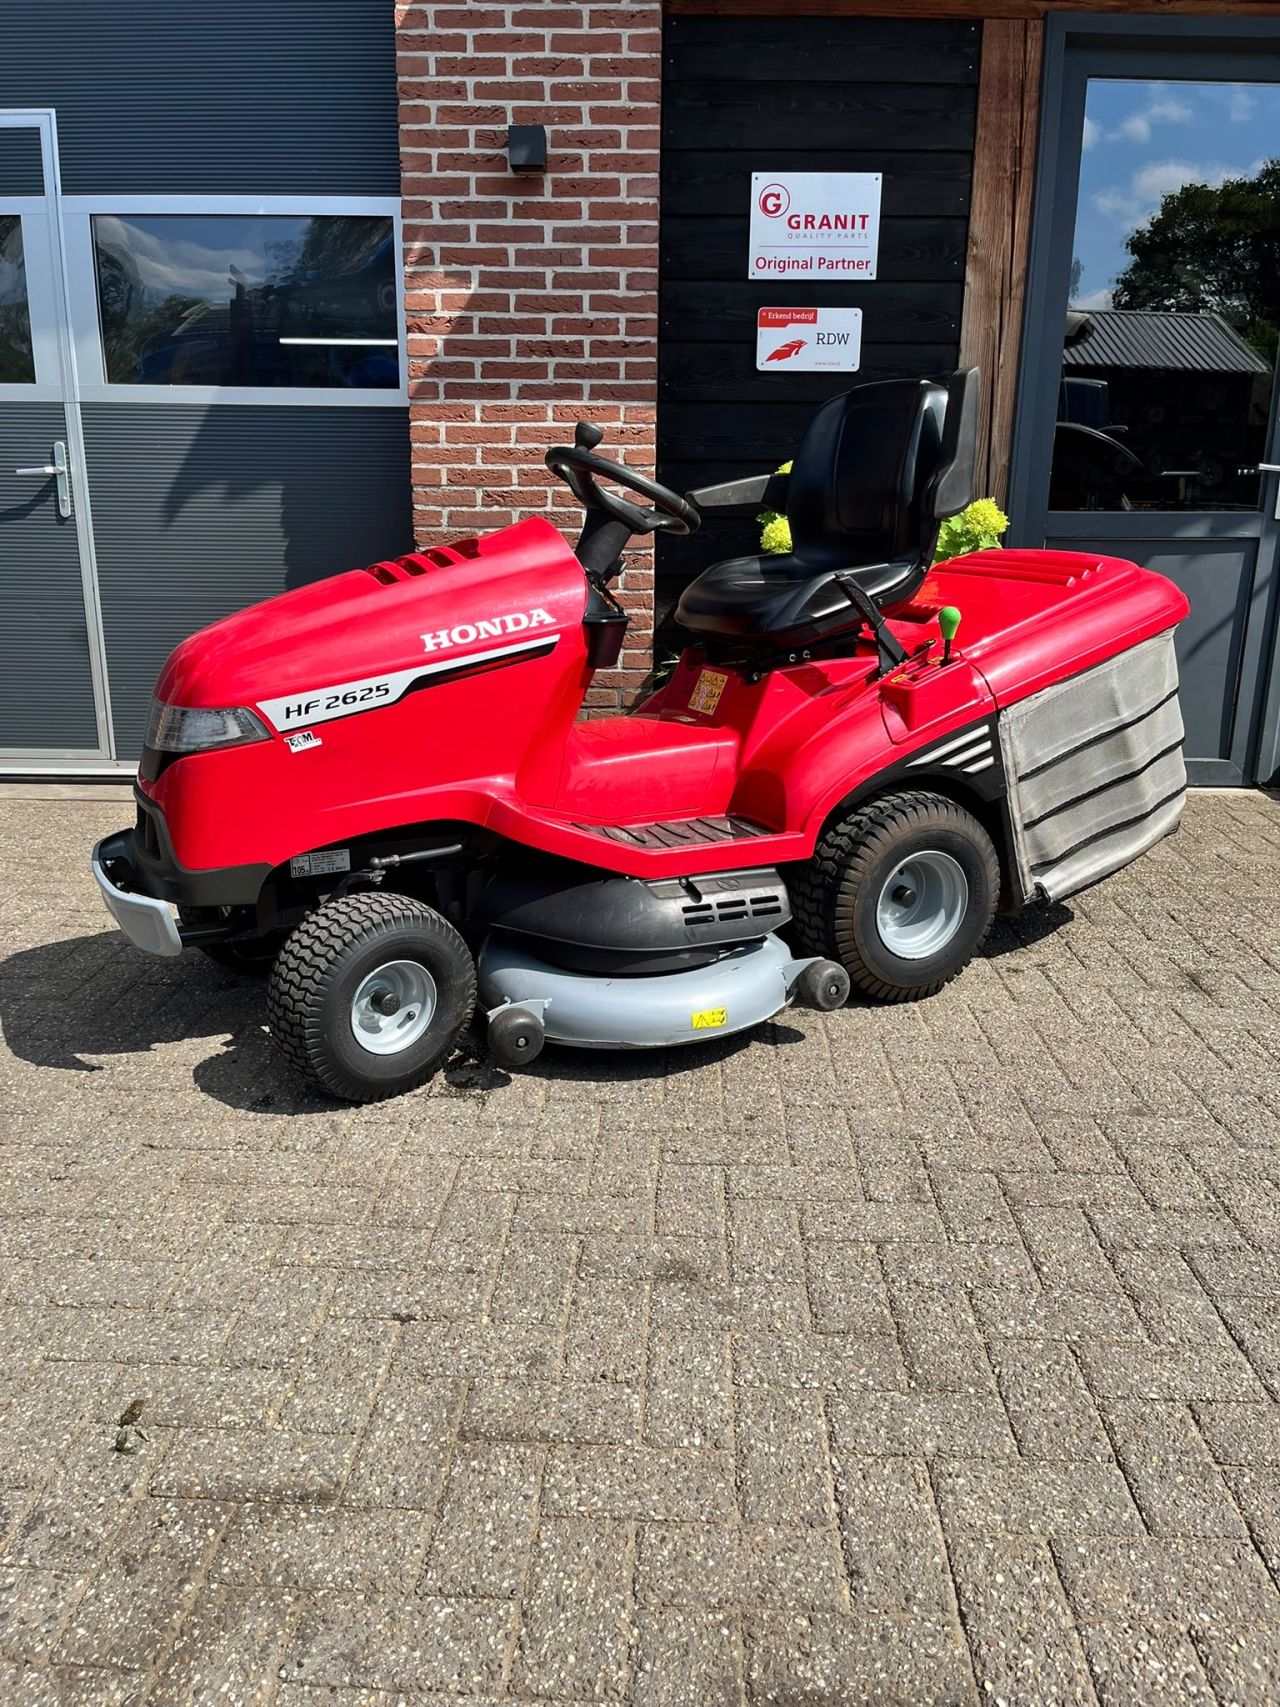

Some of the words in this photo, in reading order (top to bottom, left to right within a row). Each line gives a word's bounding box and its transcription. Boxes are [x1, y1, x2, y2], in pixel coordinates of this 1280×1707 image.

[761, 192, 782, 215] G
[787, 214, 869, 230] GRANIT
[788, 232, 832, 240] QUALITY
[755, 256, 813, 274] Original
[818, 256, 871, 270] Partner
[768, 312, 792, 320] Erkend
[792, 312, 814, 321] bedrijf
[816, 332, 850, 346] RDW
[420, 608, 556, 653] HONDA
[285, 699, 320, 719] HF
[325, 683, 390, 711] 2625
[293, 865, 306, 876] 105
